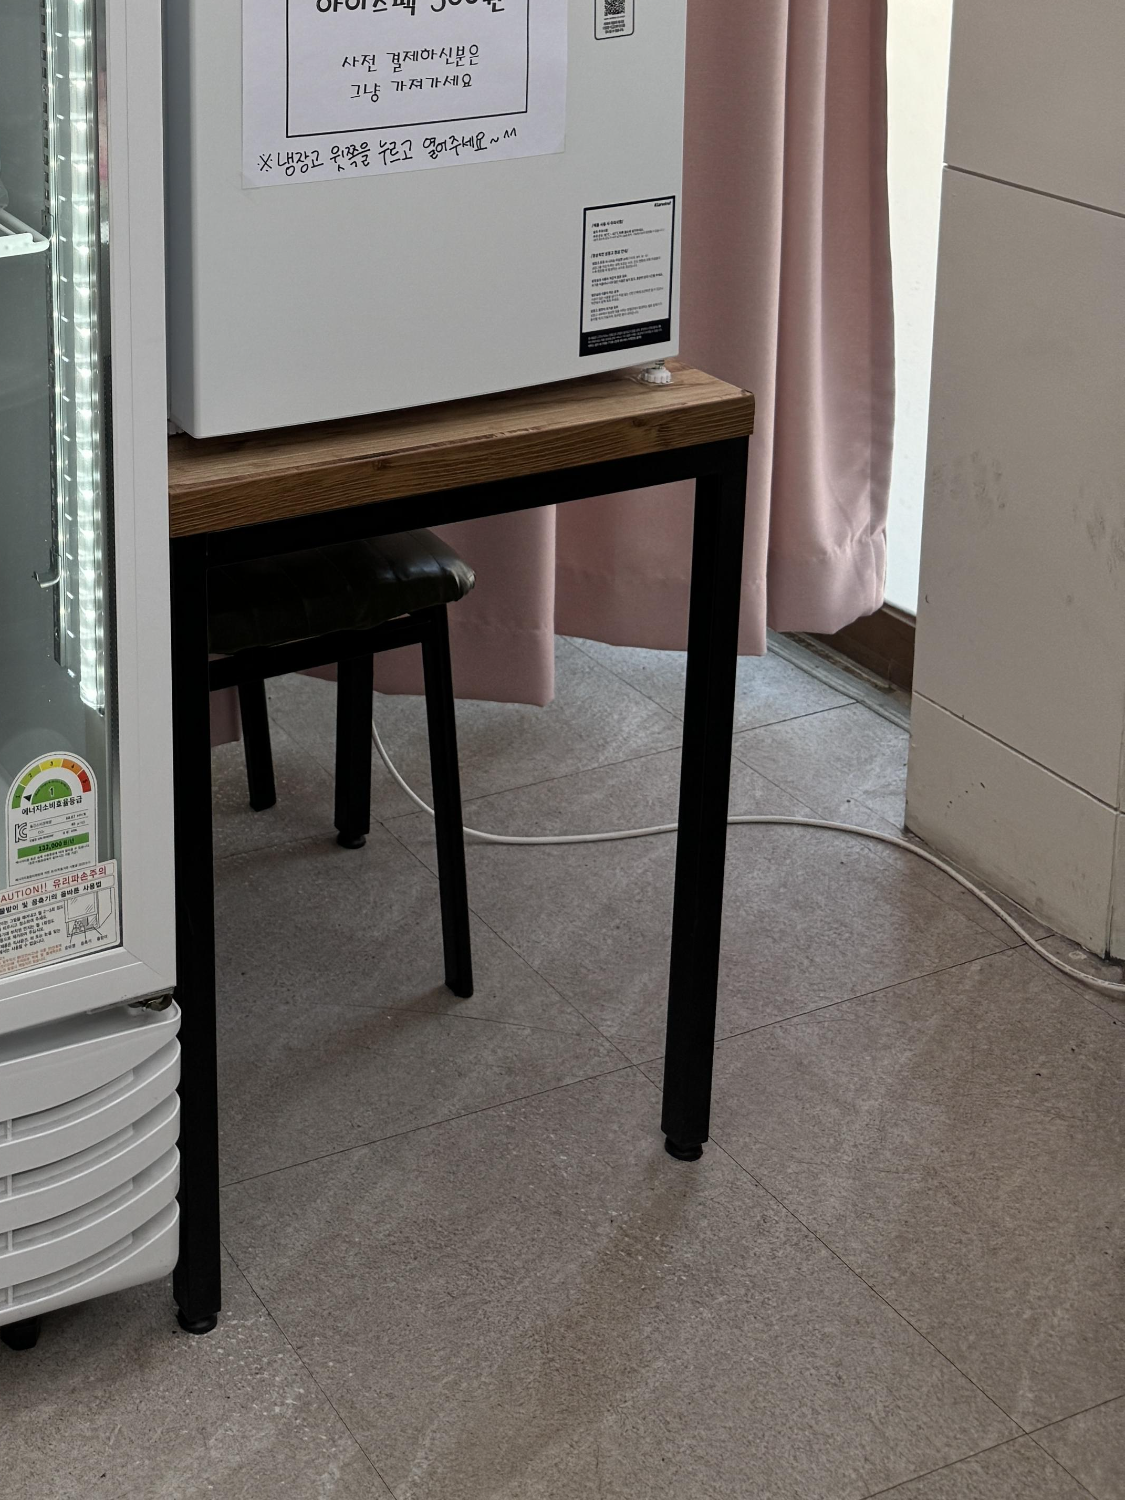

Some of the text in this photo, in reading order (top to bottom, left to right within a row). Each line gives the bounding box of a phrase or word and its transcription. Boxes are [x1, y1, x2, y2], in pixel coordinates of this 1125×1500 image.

[341, 43, 480, 74] 사전 결제하신분은
[349, 73, 473, 103] 그냥 가져가세요
[377, 139, 414, 167] 누르고
[21, 795, 83, 816] 에너지소비효율등급
[52, 865, 107, 888] 유리파손주의
[82, 880, 103, 892] 사용법
